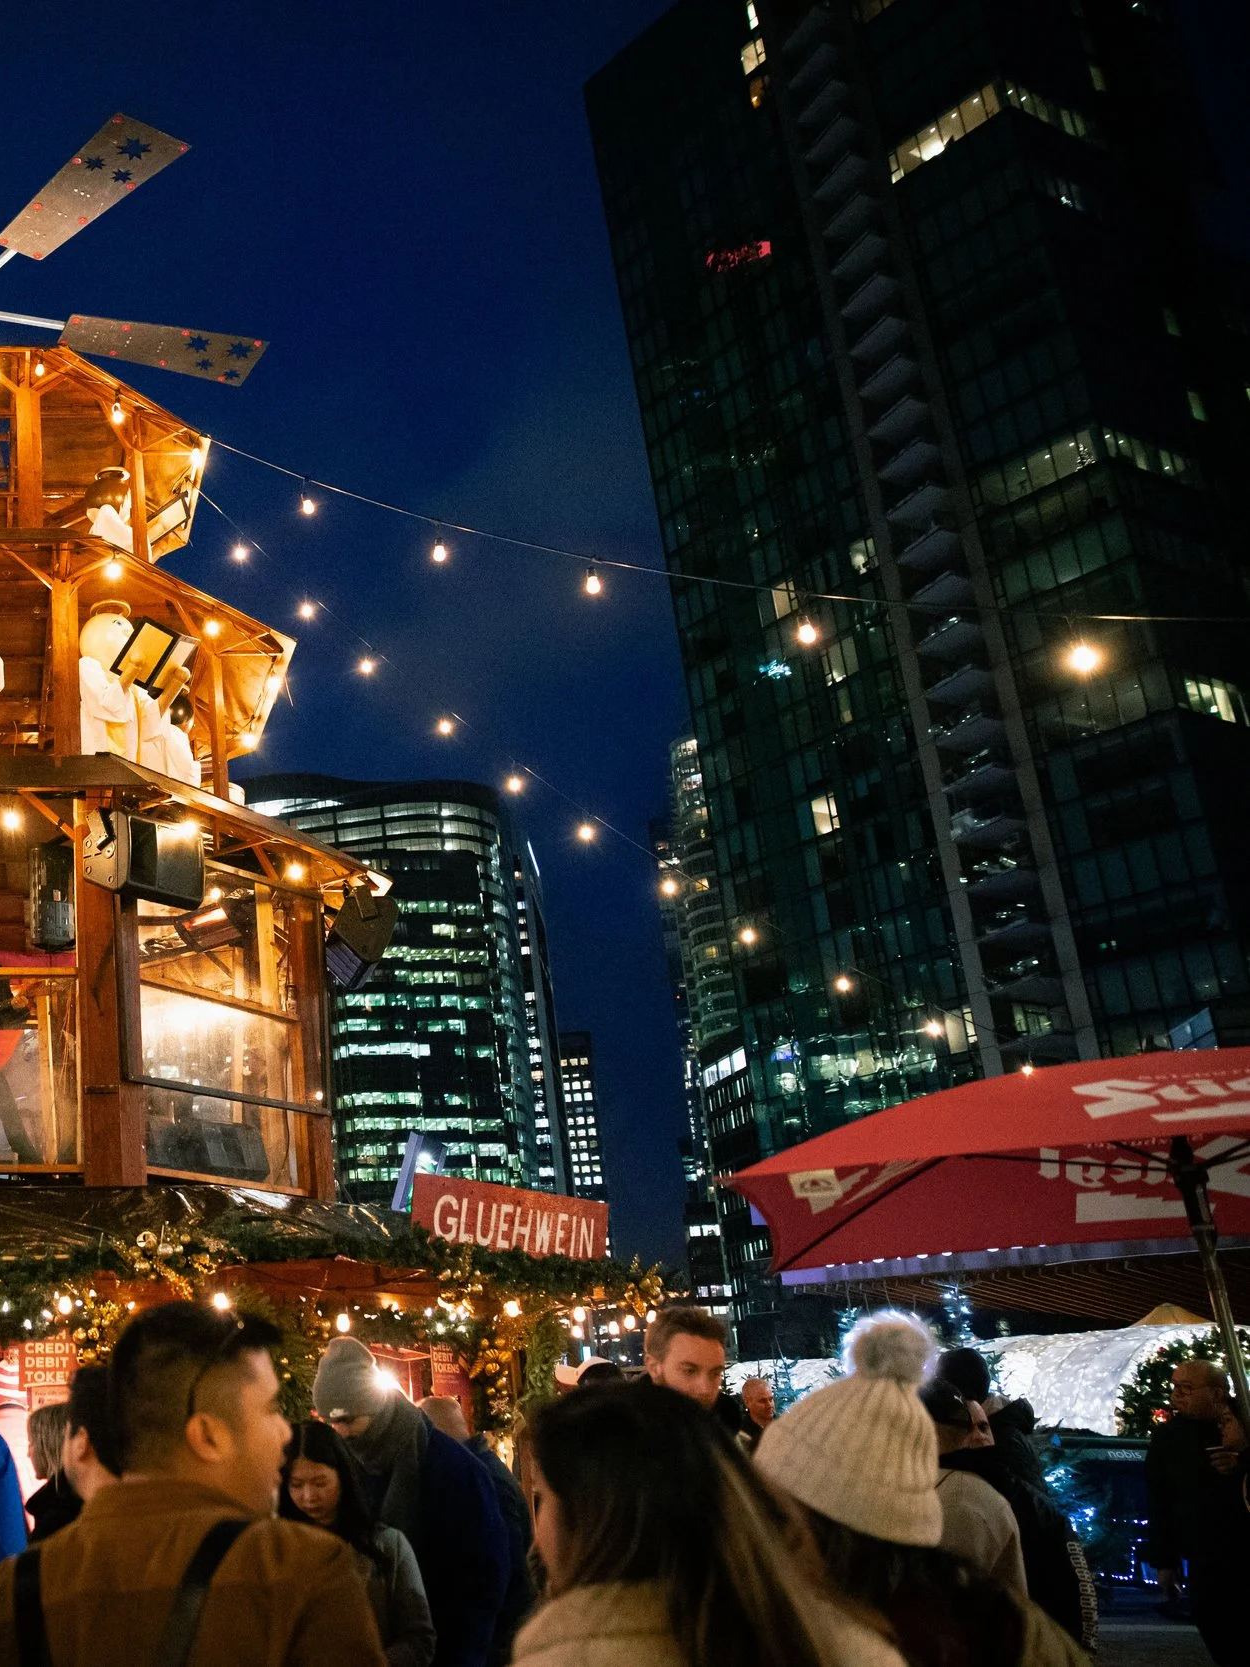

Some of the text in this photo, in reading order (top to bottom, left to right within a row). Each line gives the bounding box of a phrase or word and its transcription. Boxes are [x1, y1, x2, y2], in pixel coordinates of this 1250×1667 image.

[433, 1193, 595, 1259] GLUEHWEIN
[25, 1356, 69, 1368] DEBIT
[432, 1351, 454, 1362] DEBIT
[433, 1362, 460, 1374] TOKENS
[1107, 1449, 1143, 1460] nobis
